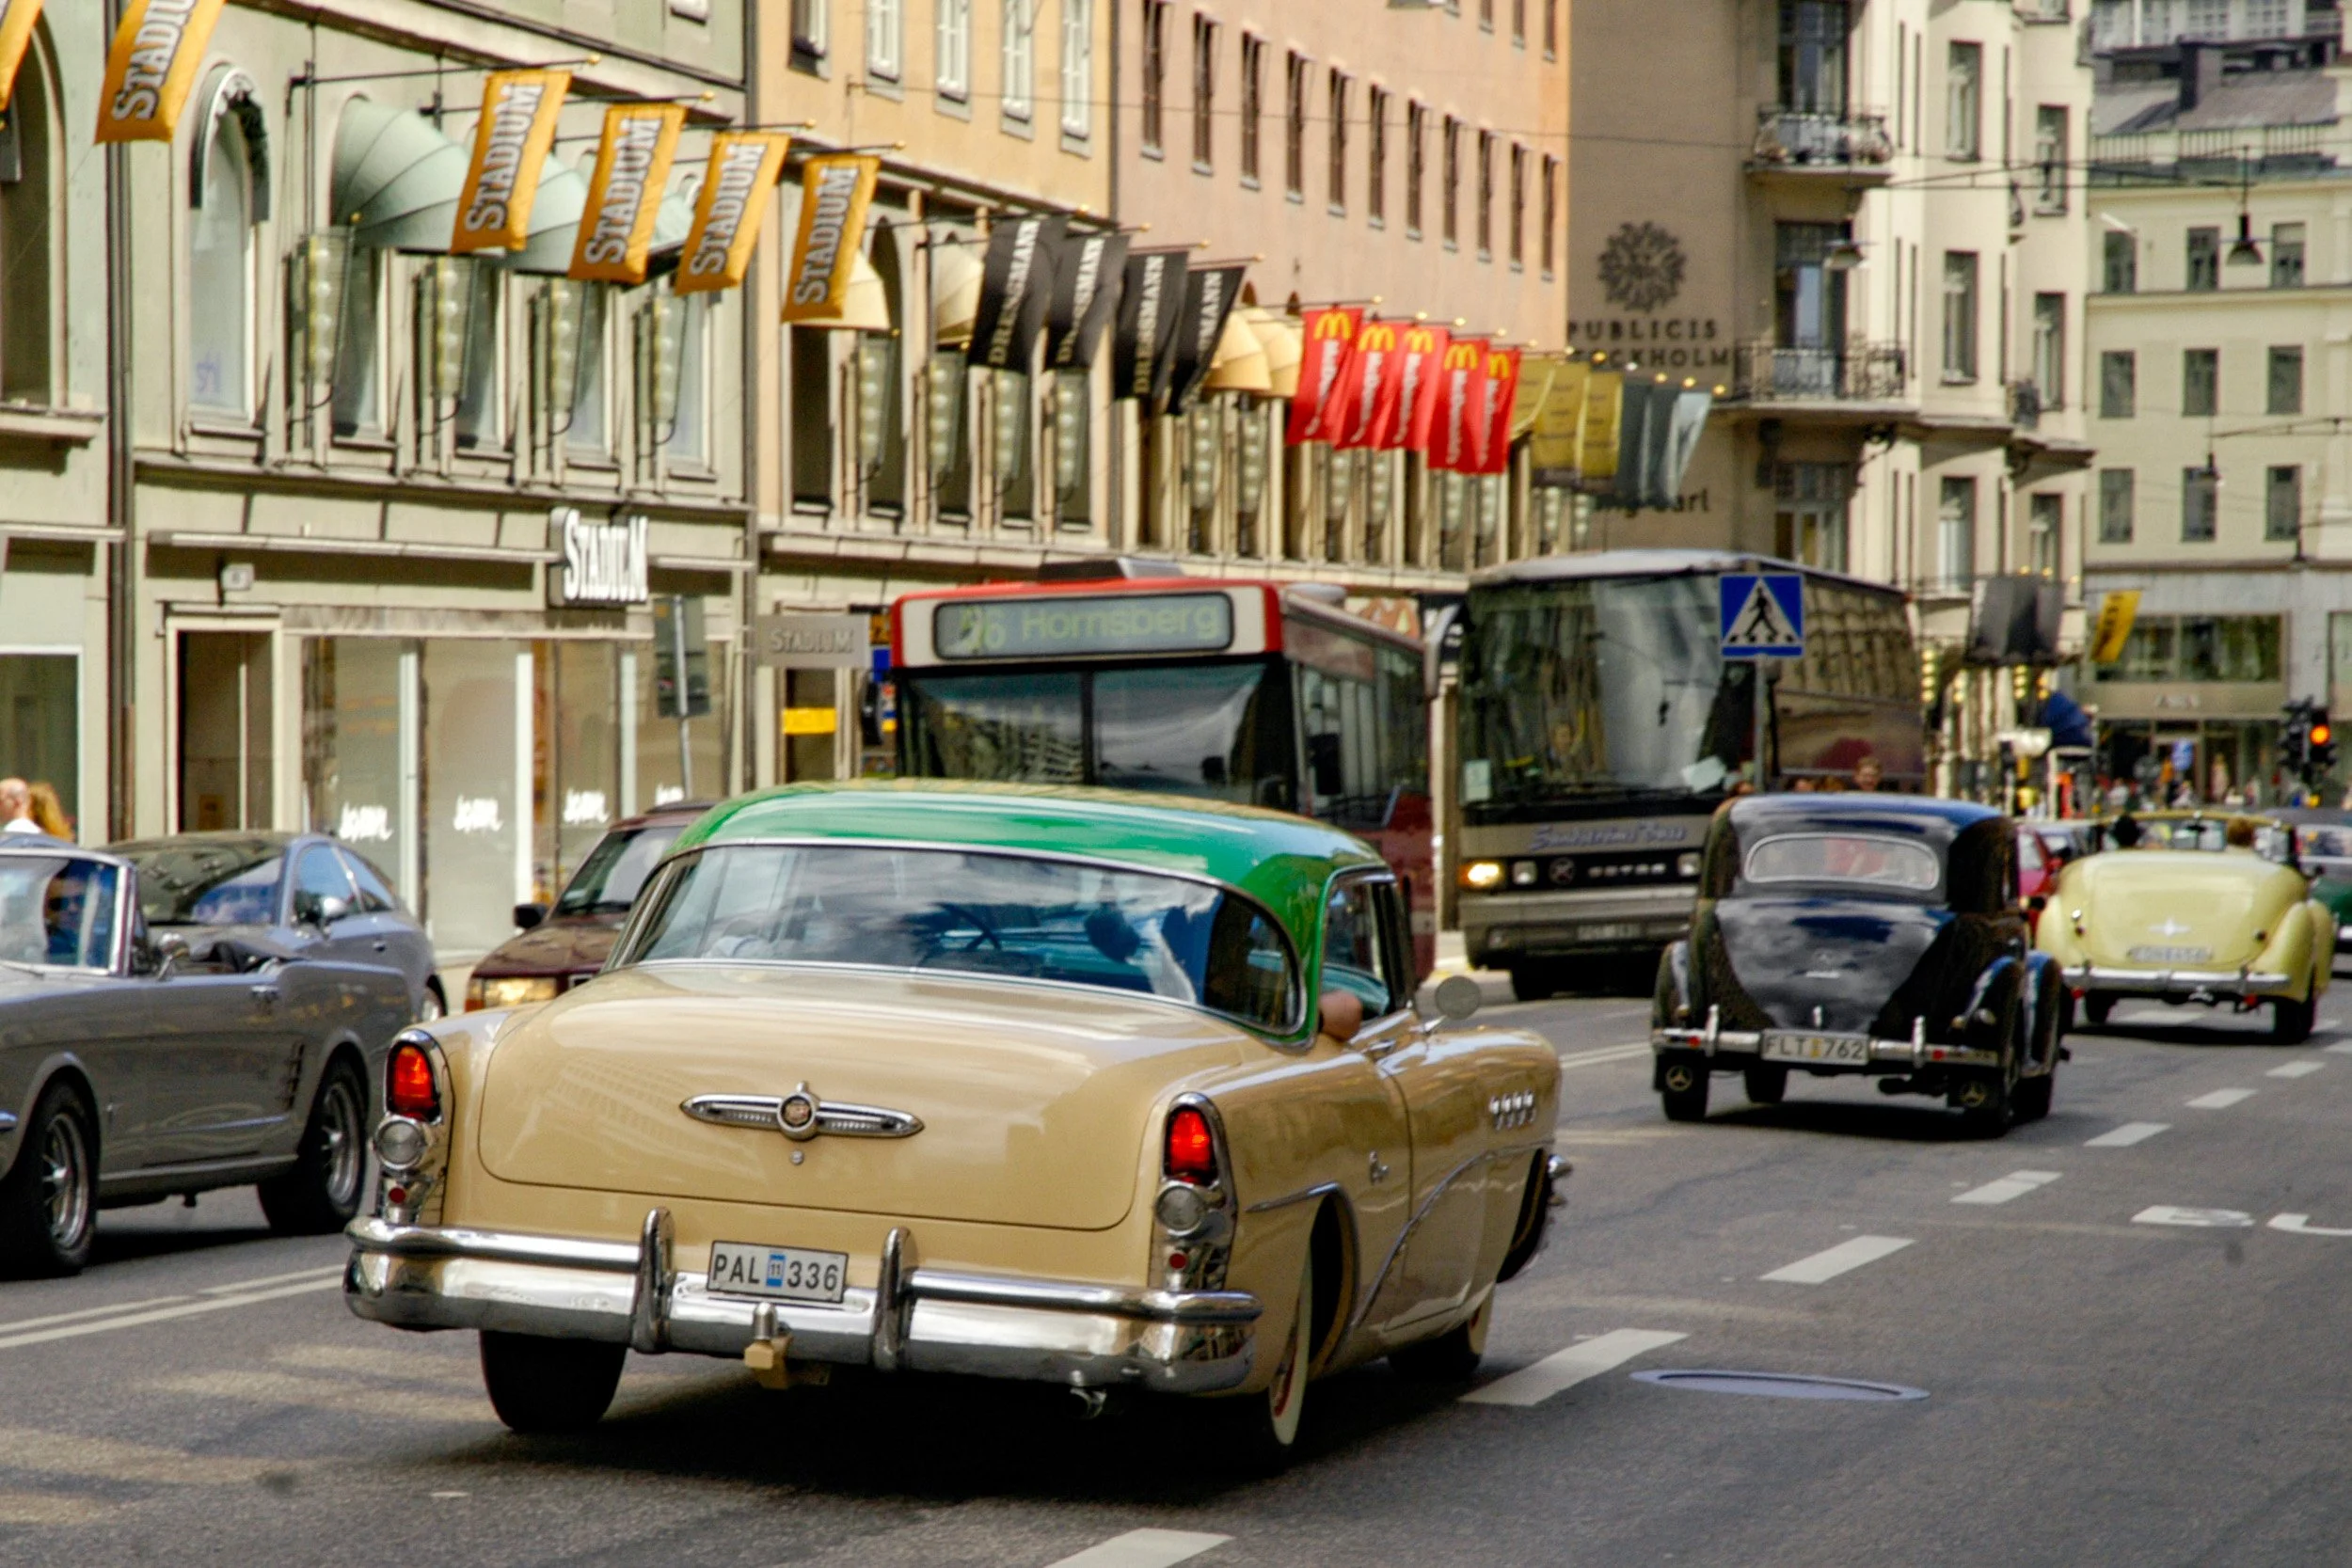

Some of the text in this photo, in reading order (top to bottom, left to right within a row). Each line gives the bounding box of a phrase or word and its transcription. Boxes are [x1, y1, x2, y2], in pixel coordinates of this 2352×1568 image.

[464, 83, 546, 231] STADIUM
[583, 118, 663, 264] STADIUM
[689, 143, 768, 276] STADIUM
[793, 166, 860, 305] STADIUM
[1056, 238, 1105, 363] DRSMANN
[1134, 256, 1165, 395] DRESSMANN
[1567, 318, 1718, 341] PUBLICIS
[1571, 347, 1729, 368] CKHOLM
[771, 627, 855, 655] STADIUM
[1022, 602, 1220, 641] Hornsberg
[1766, 1037, 1804, 1056] FLT
[1823, 1041, 1865, 1060] 762
[712, 1254, 760, 1284] PAL
[787, 1260, 839, 1291] 336
